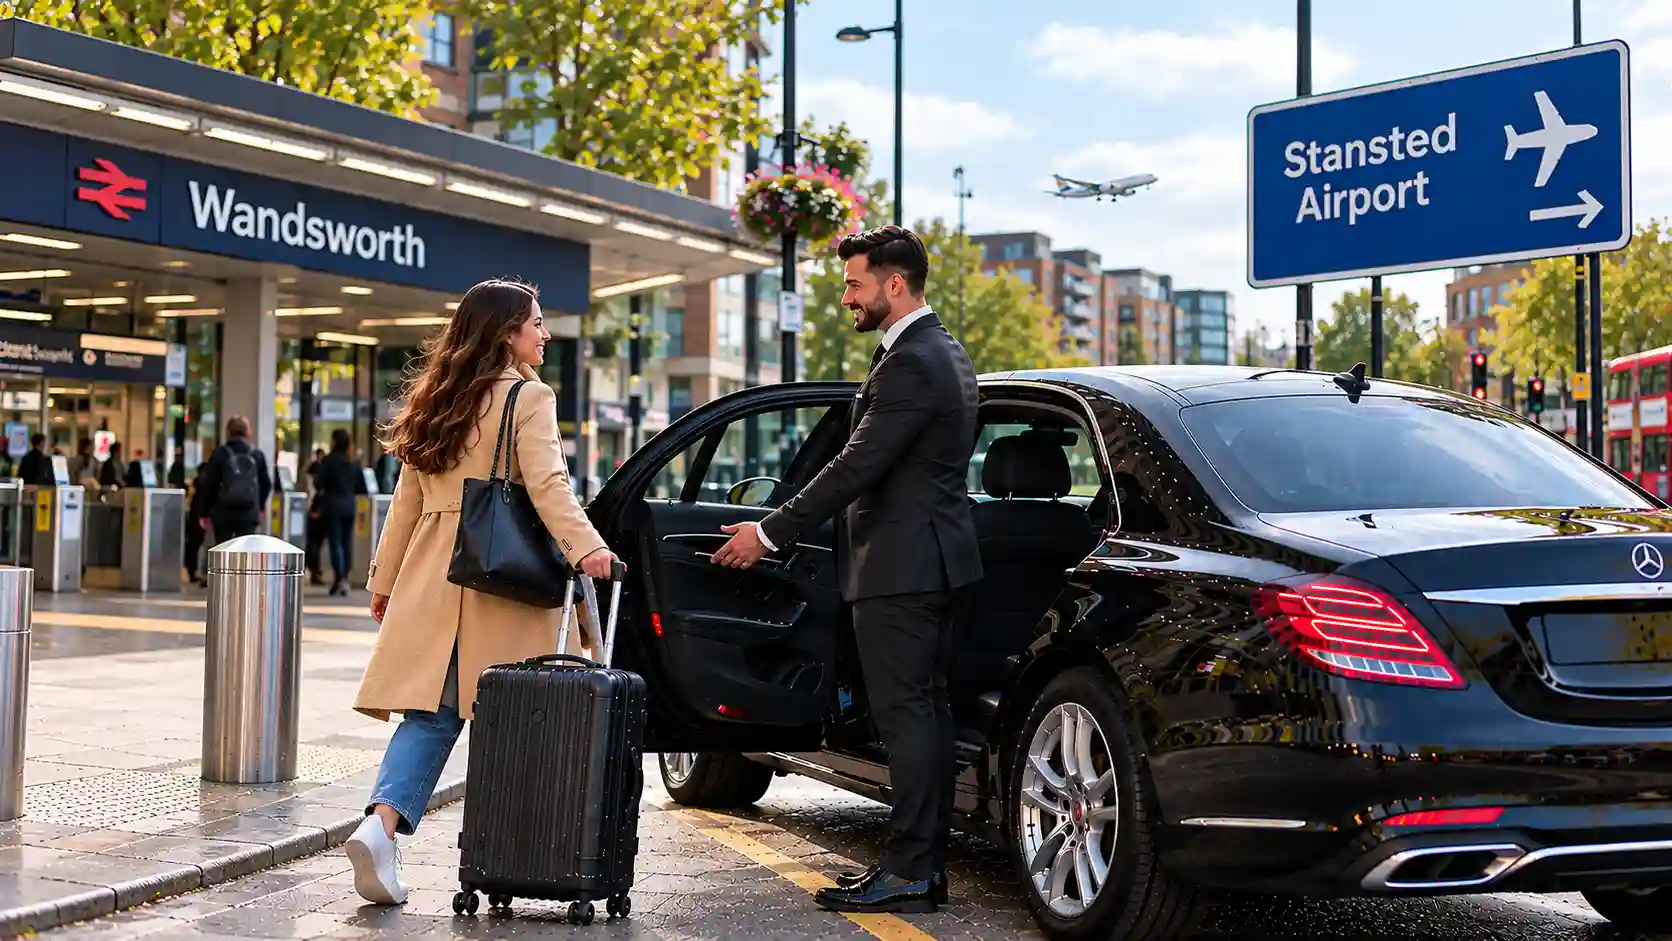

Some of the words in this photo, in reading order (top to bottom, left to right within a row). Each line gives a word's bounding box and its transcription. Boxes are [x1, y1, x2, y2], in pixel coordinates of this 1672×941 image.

[1284, 112, 1457, 179] Stansted
[188, 180, 426, 268] Wandsworth
[1296, 170, 1430, 225] Airport
